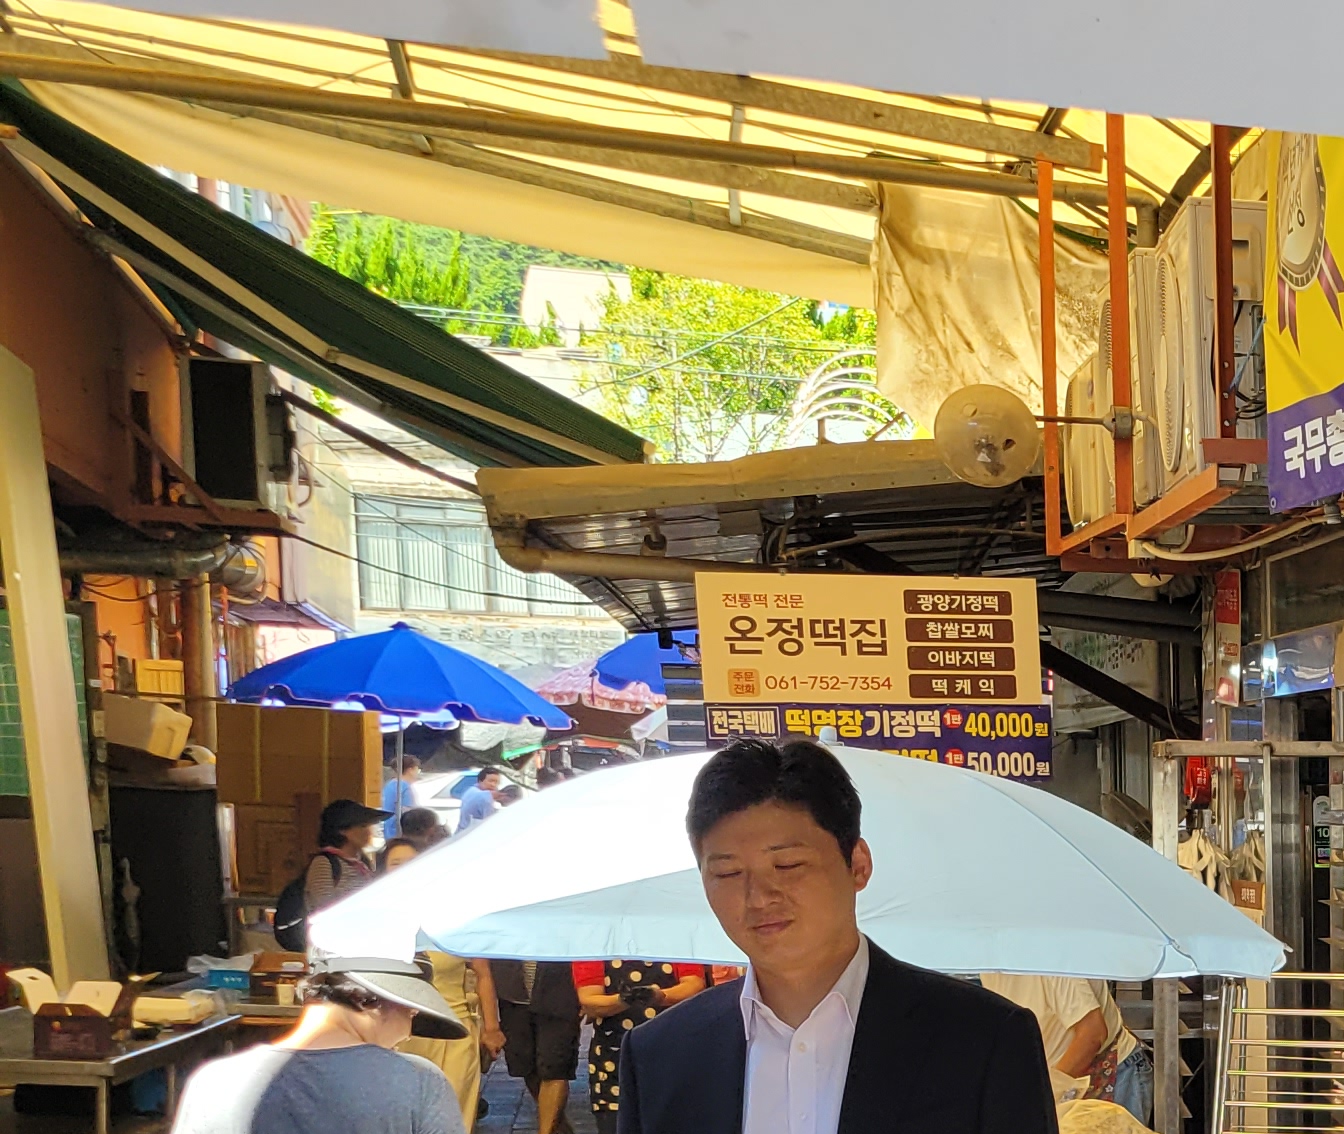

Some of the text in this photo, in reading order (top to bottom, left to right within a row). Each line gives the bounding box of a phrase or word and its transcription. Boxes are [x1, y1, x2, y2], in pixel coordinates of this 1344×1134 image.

[722, 593, 805, 609] 전통떡 전문
[917, 594, 999, 612] 광양기정떡
[724, 615, 888, 657] 온정떡집
[925, 621, 994, 640] 찹쌀모찌
[927, 650, 996, 668] 이바지떡
[765, 675, 893, 692] 061-752-7354
[711, 709, 775, 736] 전국택배
